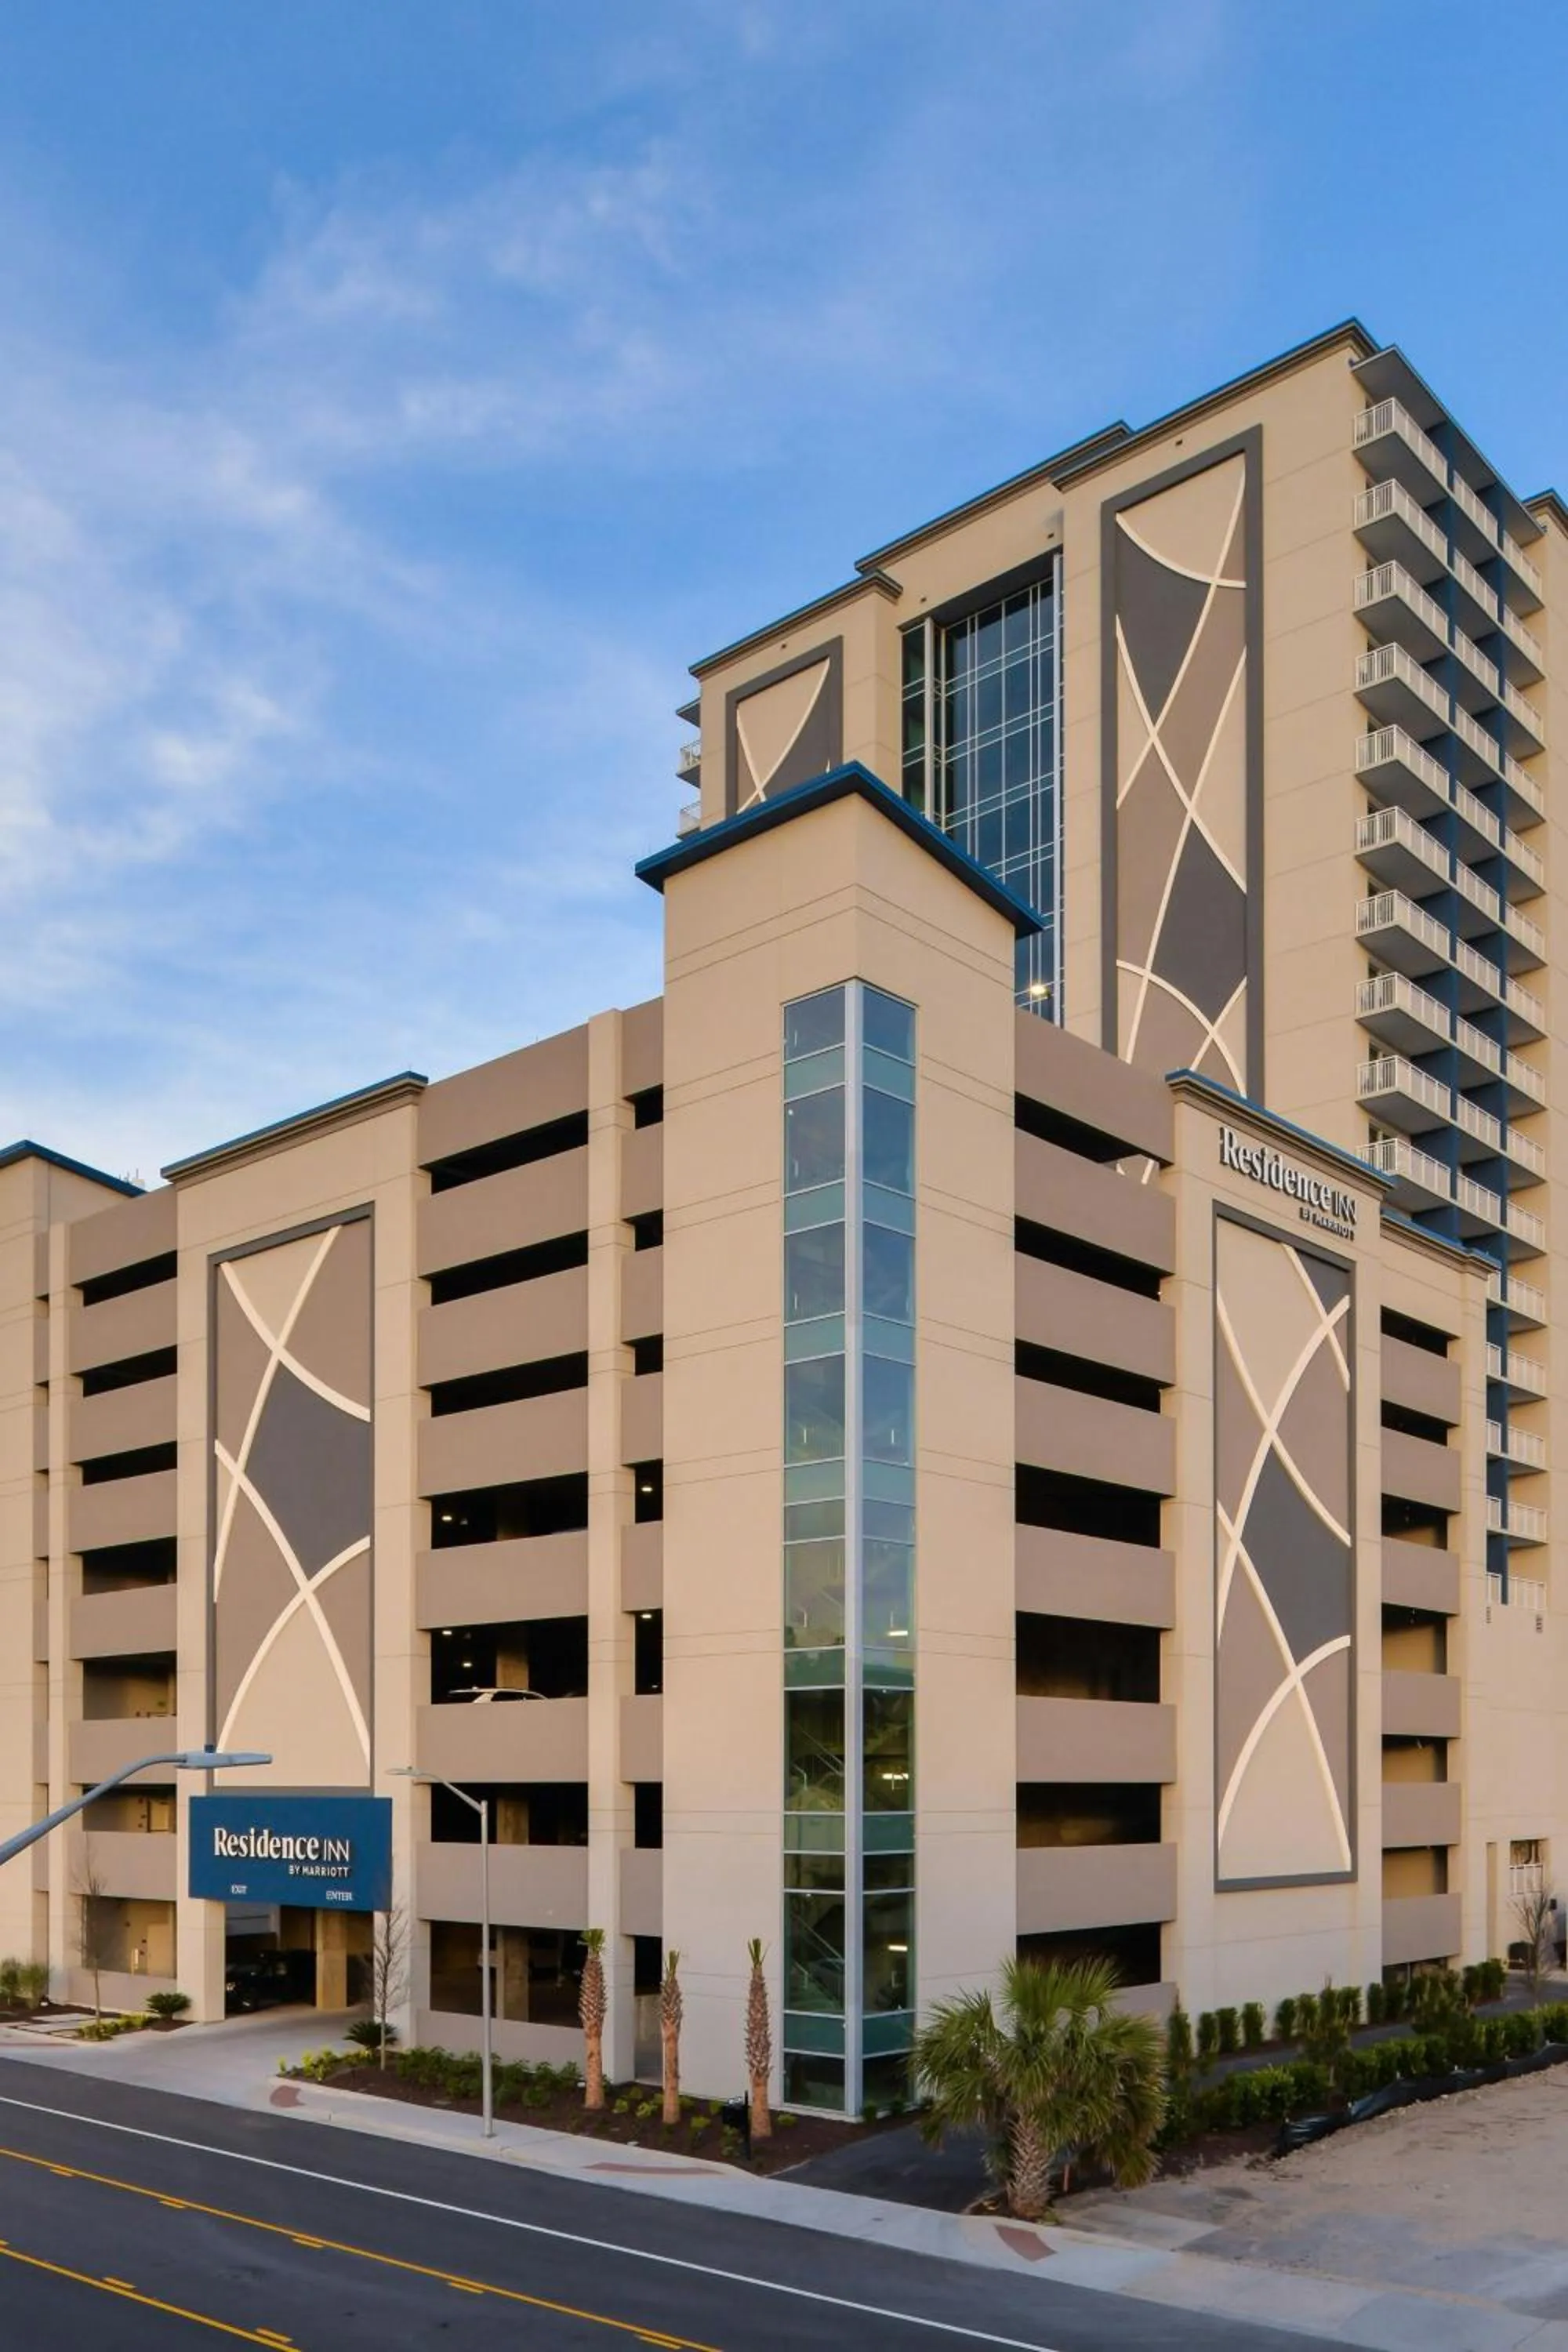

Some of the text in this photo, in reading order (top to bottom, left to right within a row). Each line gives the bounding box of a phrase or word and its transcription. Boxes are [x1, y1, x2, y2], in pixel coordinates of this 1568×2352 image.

[1220, 1127, 1358, 1225] Residence INN
[214, 1828, 350, 1862] Residence INN
[289, 1865, 350, 1877] BY MARRIOTT
[231, 1885, 249, 1895] EXIT
[325, 1890, 353, 1901] ENTER
